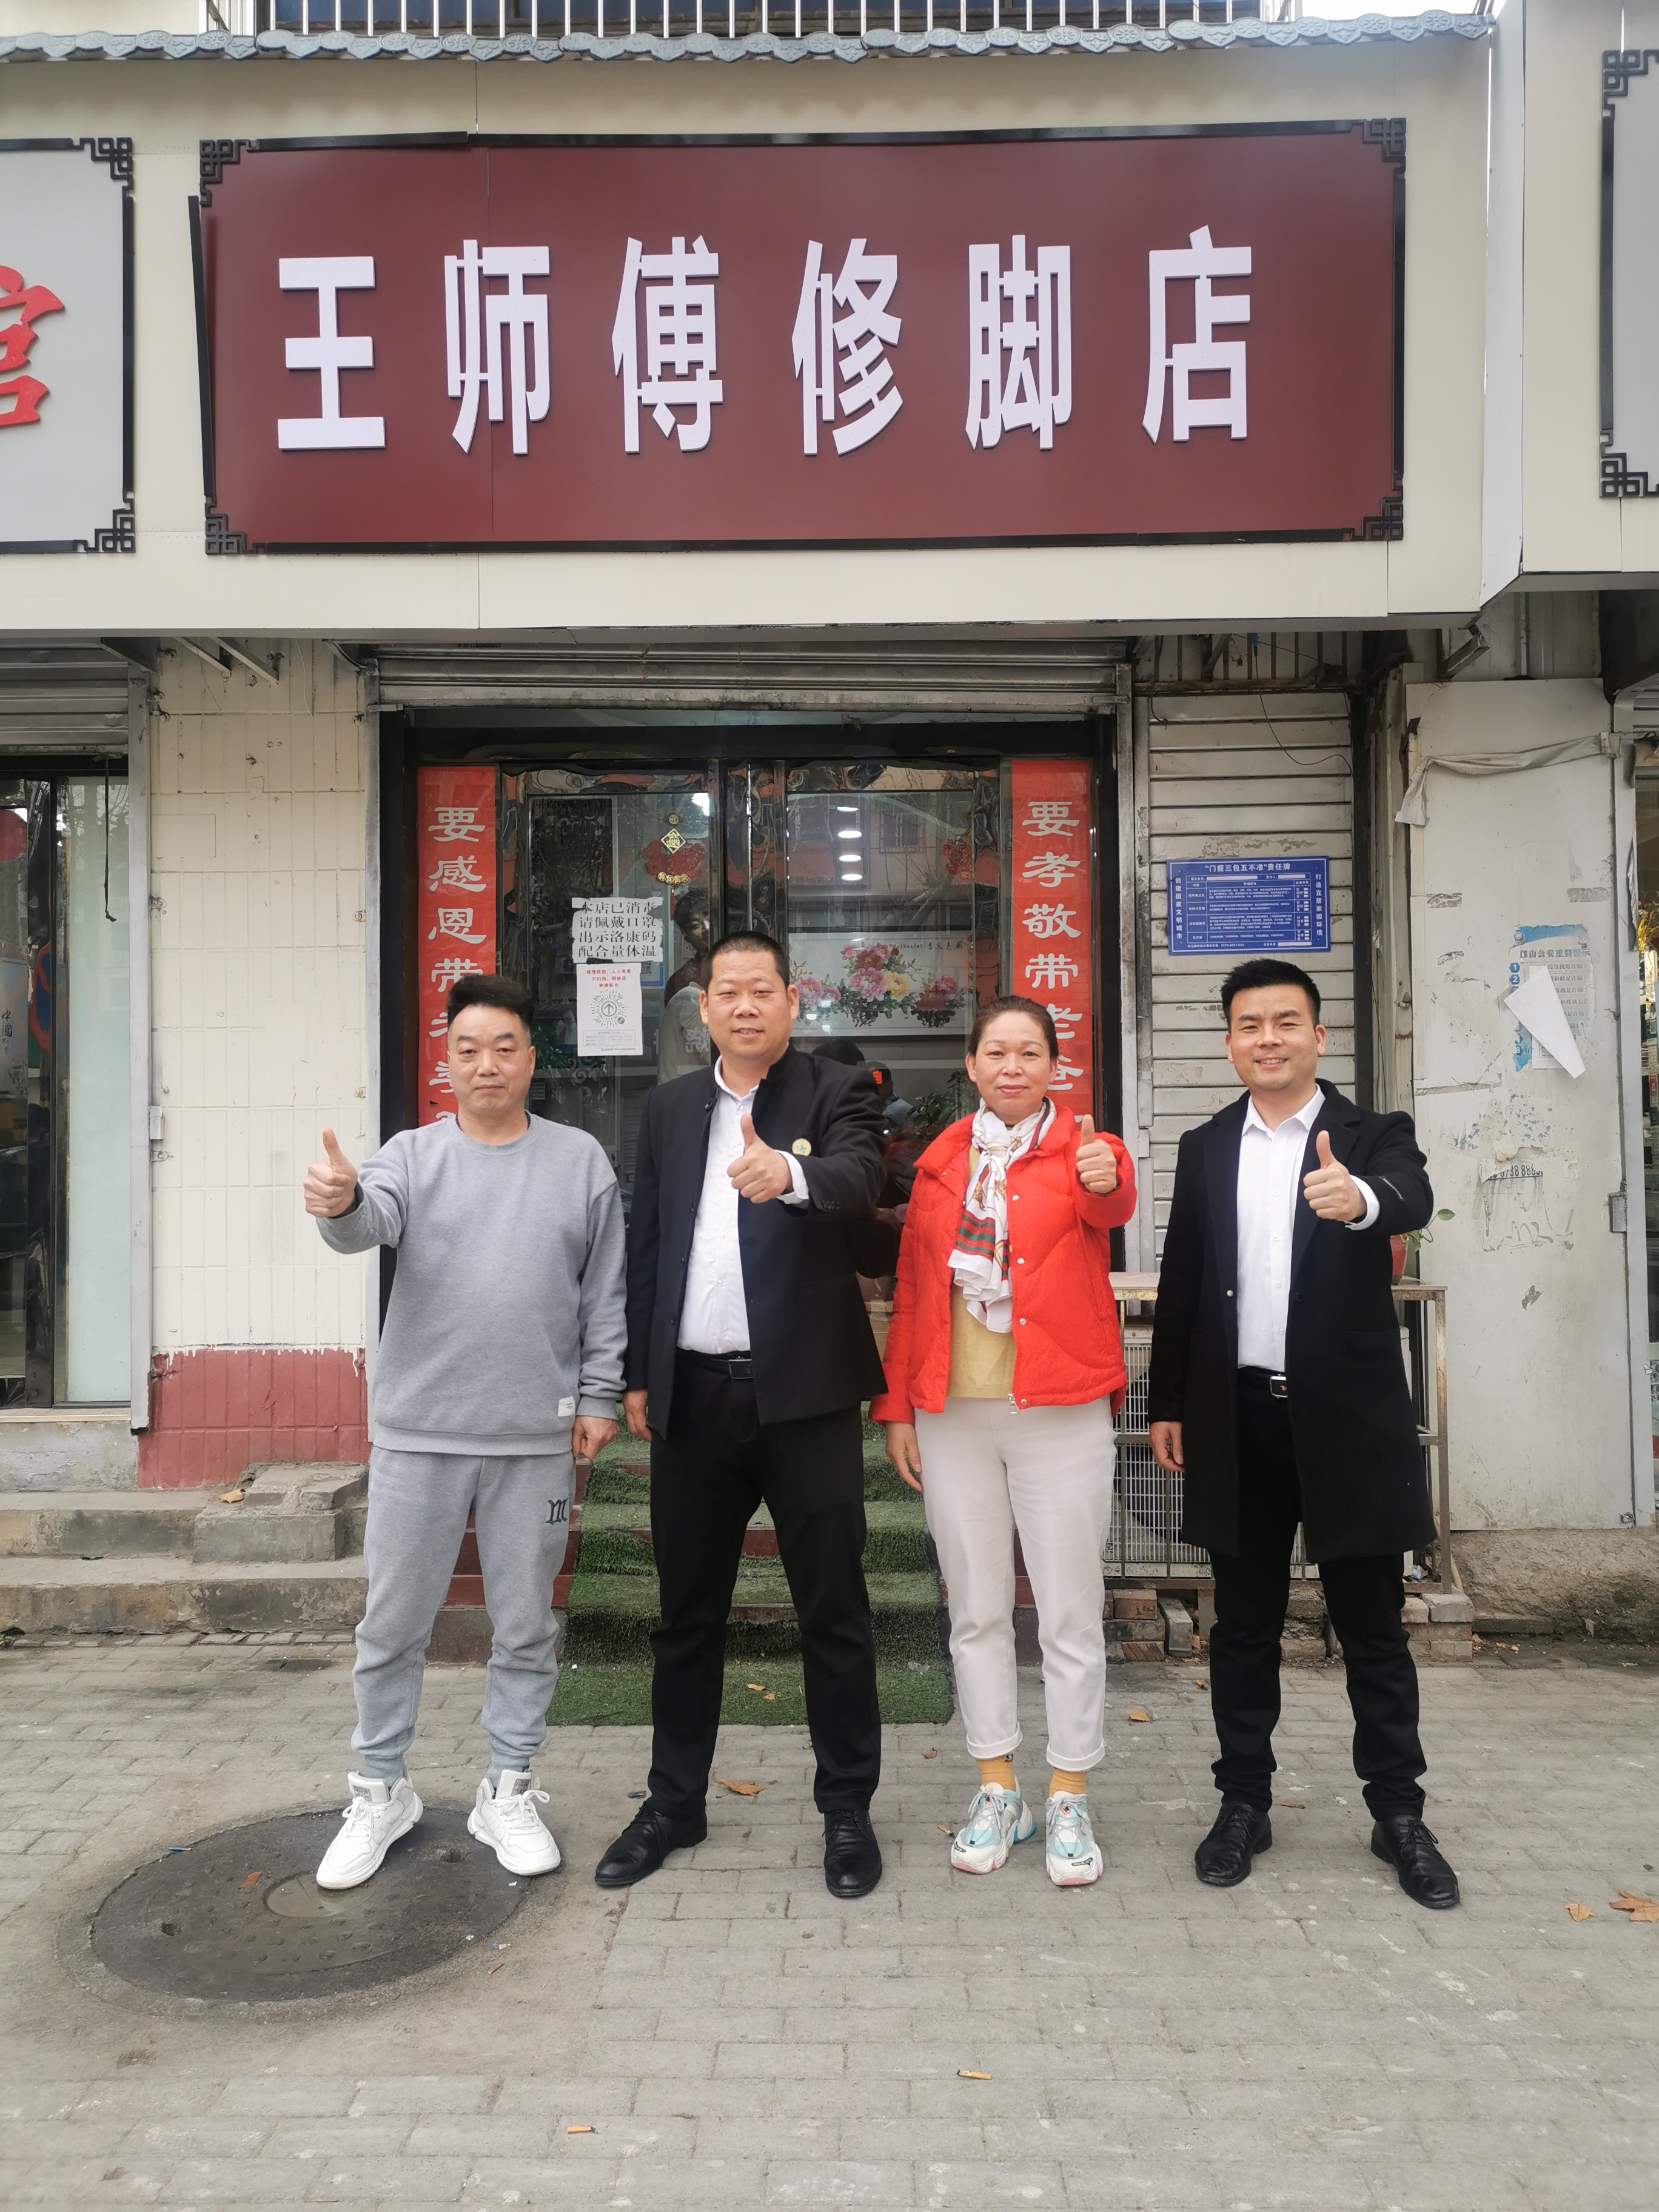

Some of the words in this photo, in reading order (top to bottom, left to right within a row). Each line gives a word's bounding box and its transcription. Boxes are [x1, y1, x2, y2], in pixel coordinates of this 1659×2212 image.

[276, 225, 1253, 455] 王师傅修脚店
[580, 901, 656, 914] 本店已消毒
[579, 916, 657, 929] 请佩戴口罩
[578, 930, 657, 943] 出示洛康码
[578, 944, 657, 958] 配合量体温
